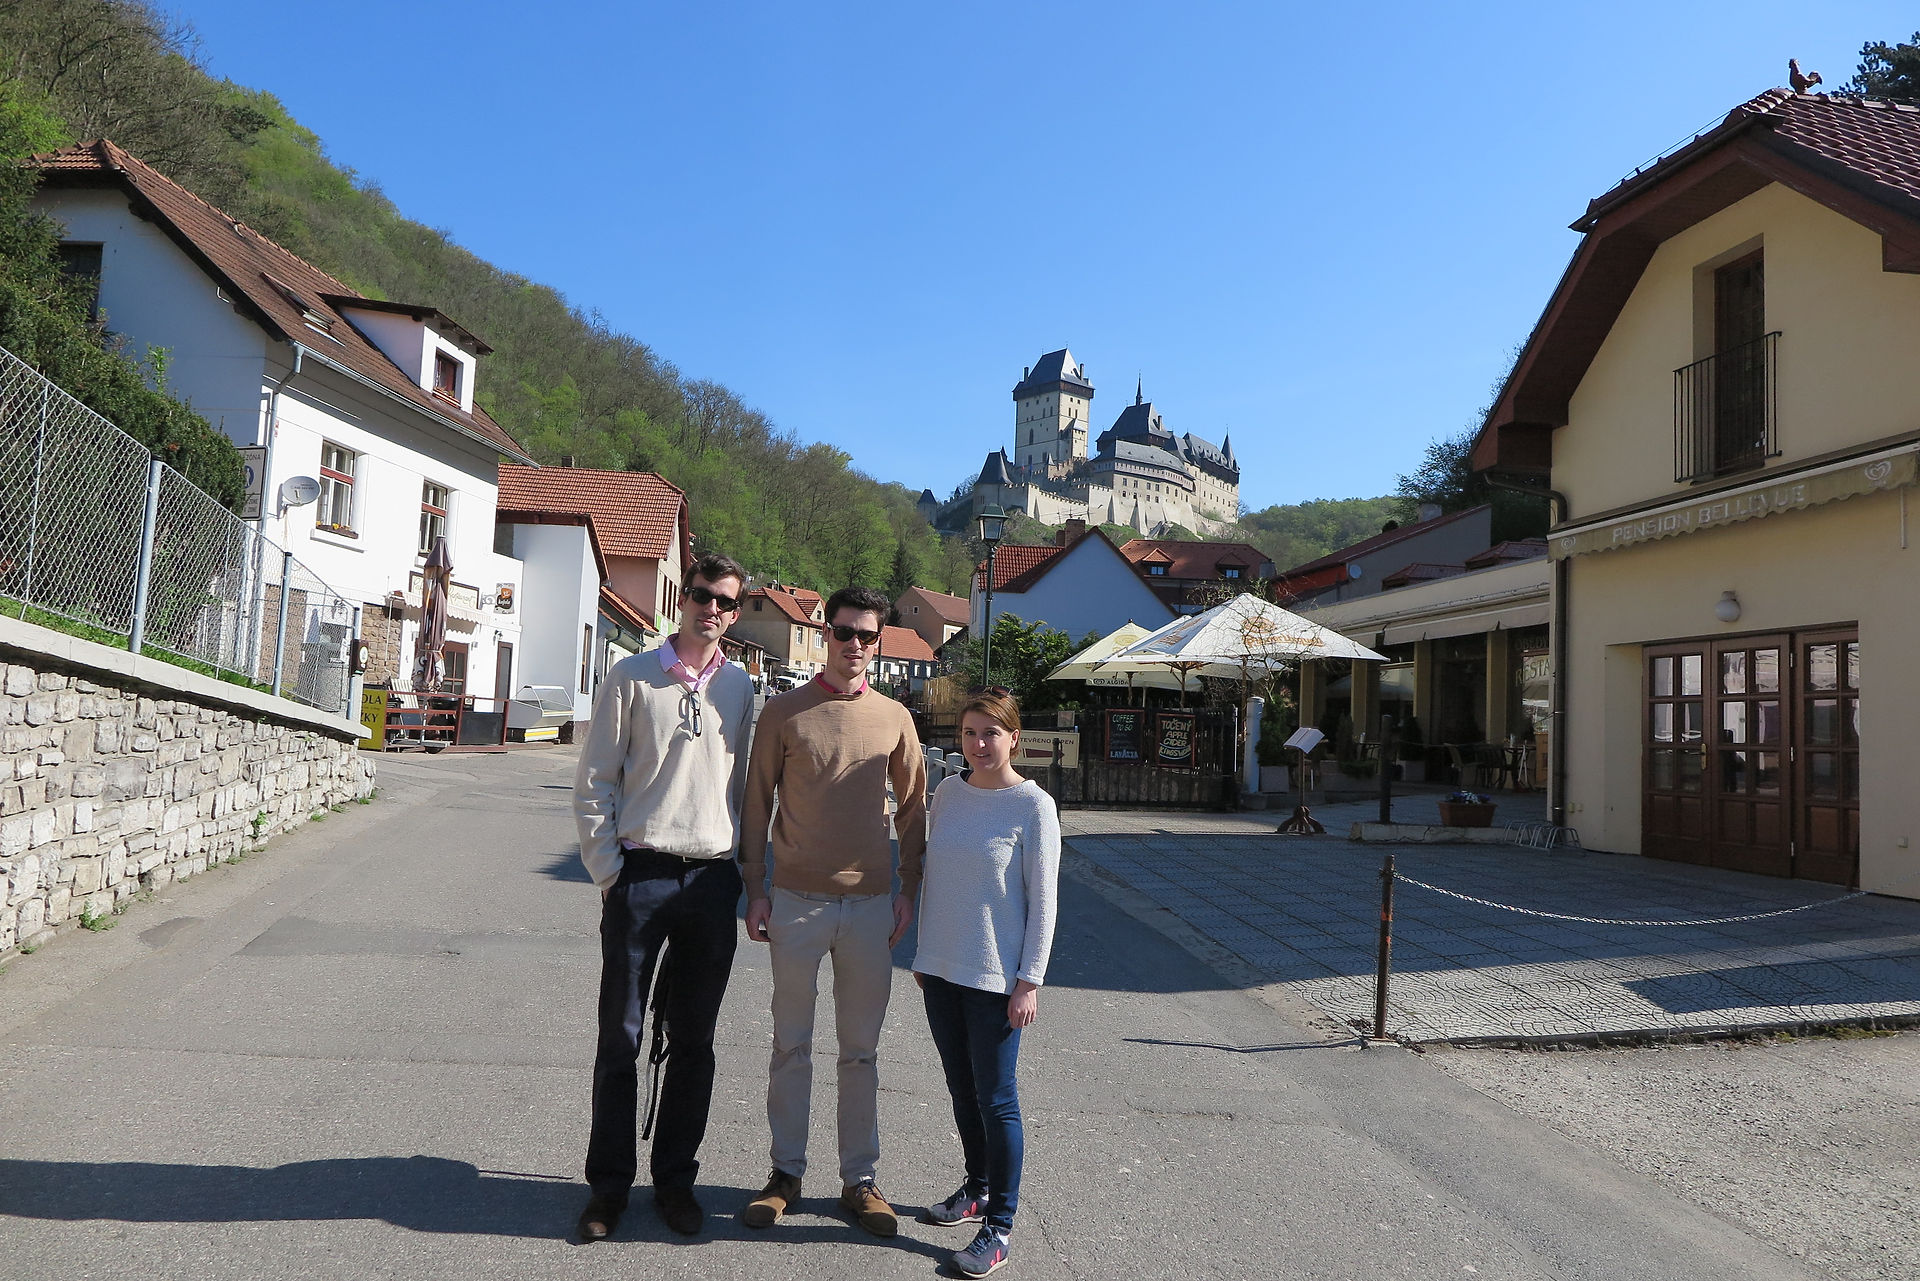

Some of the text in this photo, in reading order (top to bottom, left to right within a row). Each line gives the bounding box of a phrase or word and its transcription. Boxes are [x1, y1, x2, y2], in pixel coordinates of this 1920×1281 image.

[1612, 511, 1690, 543] PENSION
[1515, 659, 1550, 688] RESTA
[362, 694, 382, 705] OLA
[1112, 714, 1135, 723] COFFEE
[1166, 731, 1188, 739] APPLE
[1163, 738, 1187, 747] CIDER
